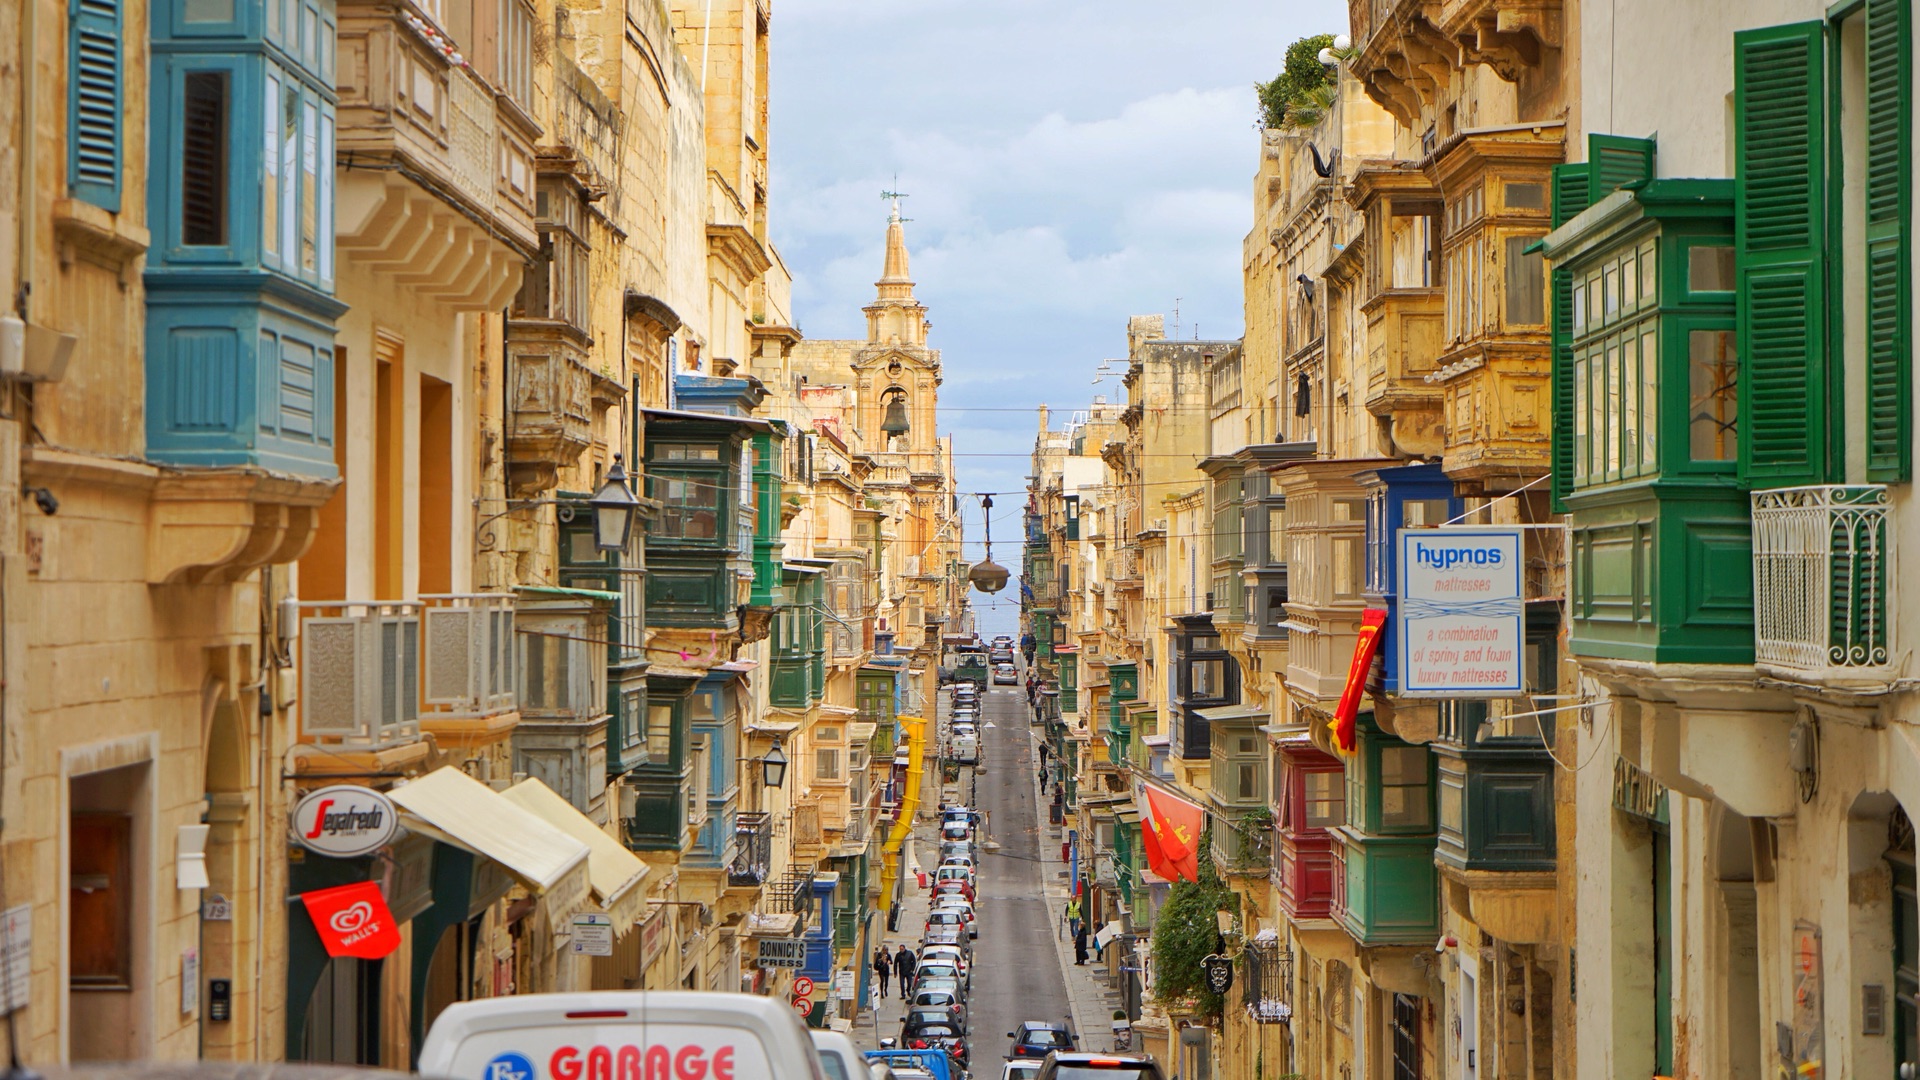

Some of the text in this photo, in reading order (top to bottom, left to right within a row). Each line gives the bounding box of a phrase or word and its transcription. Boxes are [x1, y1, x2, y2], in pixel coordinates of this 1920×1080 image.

[1417, 542, 1502, 569] hypnos
[1434, 577, 1491, 592] mattresses
[1427, 625, 1498, 641] a combination
[1414, 647, 1511, 665] of spring and foam
[1417, 668, 1508, 686] luxury mattresses
[306, 799, 383, 839] Segafredo
[341, 923, 379, 947] WALL'S
[760, 941, 805, 959] BONNICI'S
[760, 958, 804, 968] PRESS
[549, 1044, 735, 1080] GARAGE
